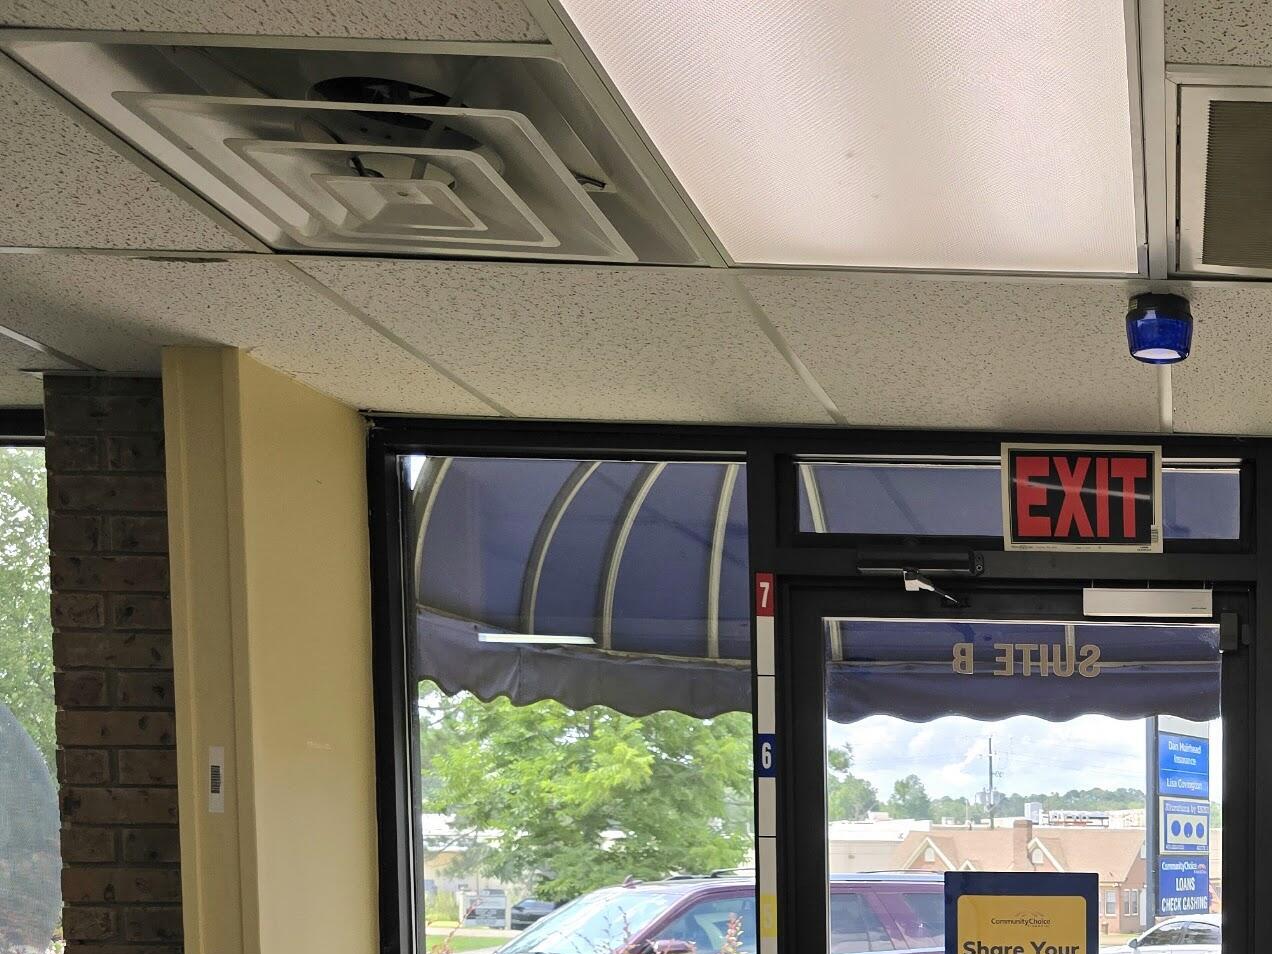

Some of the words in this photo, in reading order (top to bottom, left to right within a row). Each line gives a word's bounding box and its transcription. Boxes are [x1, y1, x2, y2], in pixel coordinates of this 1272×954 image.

[1015, 456, 1147, 538] EXIT
[759, 581, 770, 608] 7
[761, 742, 772, 769] 6
[1175, 876, 1196, 892] LOANS
[763, 904, 773, 929] 5
[1161, 897, 1182, 913] CHECK
[1182, 895, 1208, 911] CASHING
[991, 918, 1050, 926] CommunityChoice
